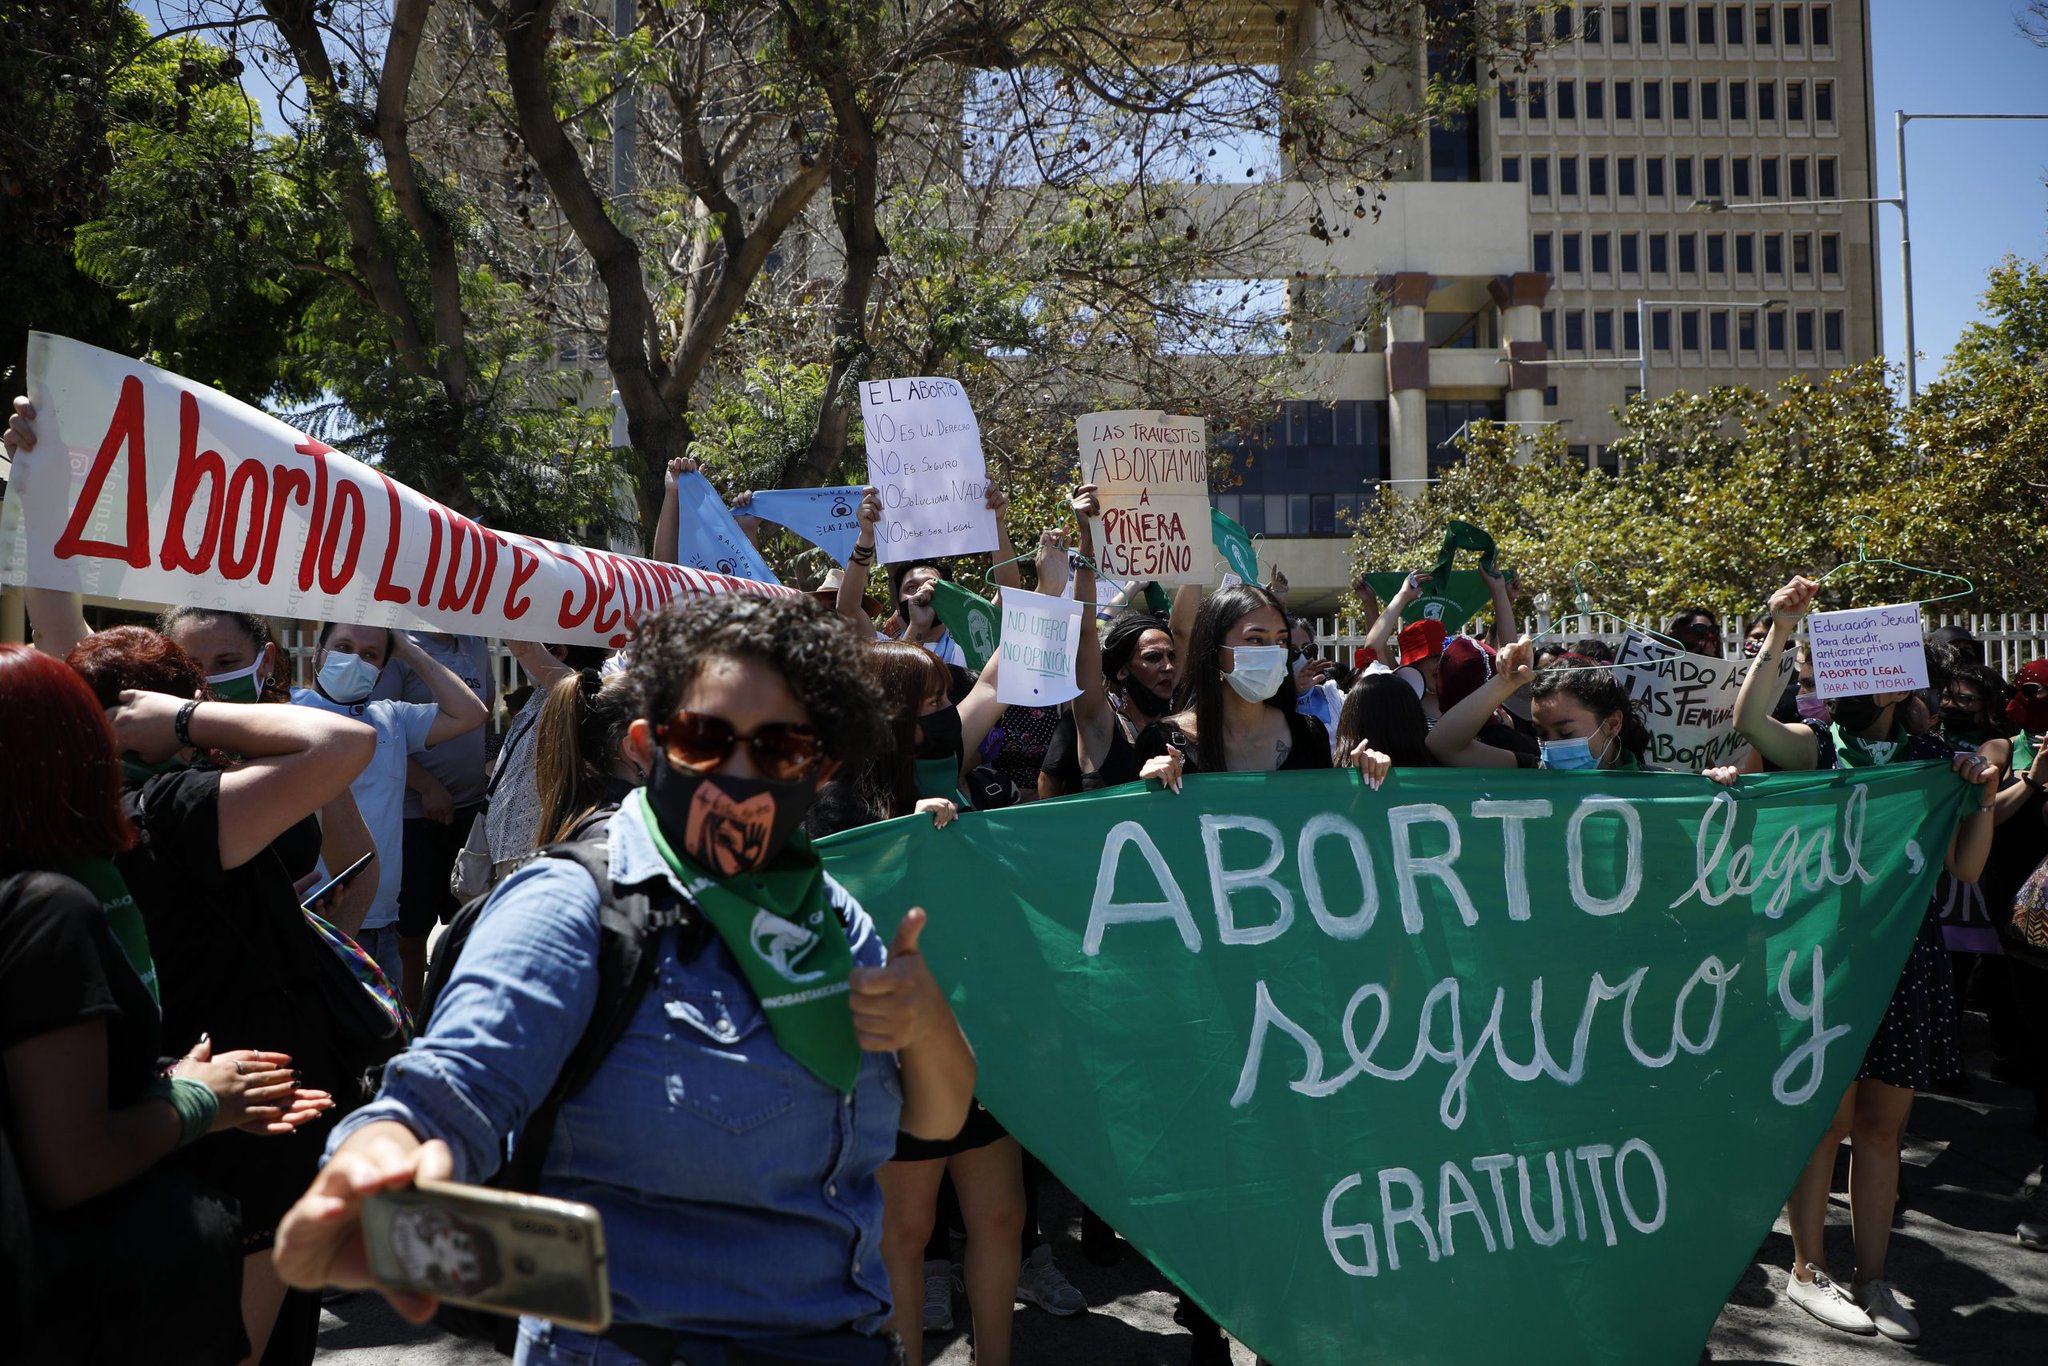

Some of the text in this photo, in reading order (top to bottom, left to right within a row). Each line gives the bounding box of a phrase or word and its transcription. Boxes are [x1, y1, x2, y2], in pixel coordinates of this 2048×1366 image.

[868, 380, 958, 405] EL ABORTO
[862, 413, 896, 445] NO
[1092, 424, 1125, 442] LAS
[866, 448, 901, 478] NO
[1091, 446, 1206, 484] ABORTAMOS
[1139, 487, 1150, 506] A
[823, 524, 836, 533] LAS
[837, 522, 843, 531] 2
[874, 520, 903, 546] NO
[1007, 610, 1069, 642] NO UTERO
[1813, 609, 1918, 634] Educación Sexual
[1816, 640, 1920, 659] anticonceptivos para
[1842, 632, 1881, 646] decidir,
[1003, 641, 1071, 673] NO OPINIÓN
[1617, 635, 1716, 684] ESTADO
[1818, 657, 1875, 669] no abortar
[1819, 665, 1906, 679] ABORTO LEGAL
[1823, 677, 1916, 693] PARA NO MORIR
[1083, 793, 1644, 956] ABORTO
[1230, 944, 1851, 1130] seguro y
[1323, 1138, 1666, 1277] GRATUITO
